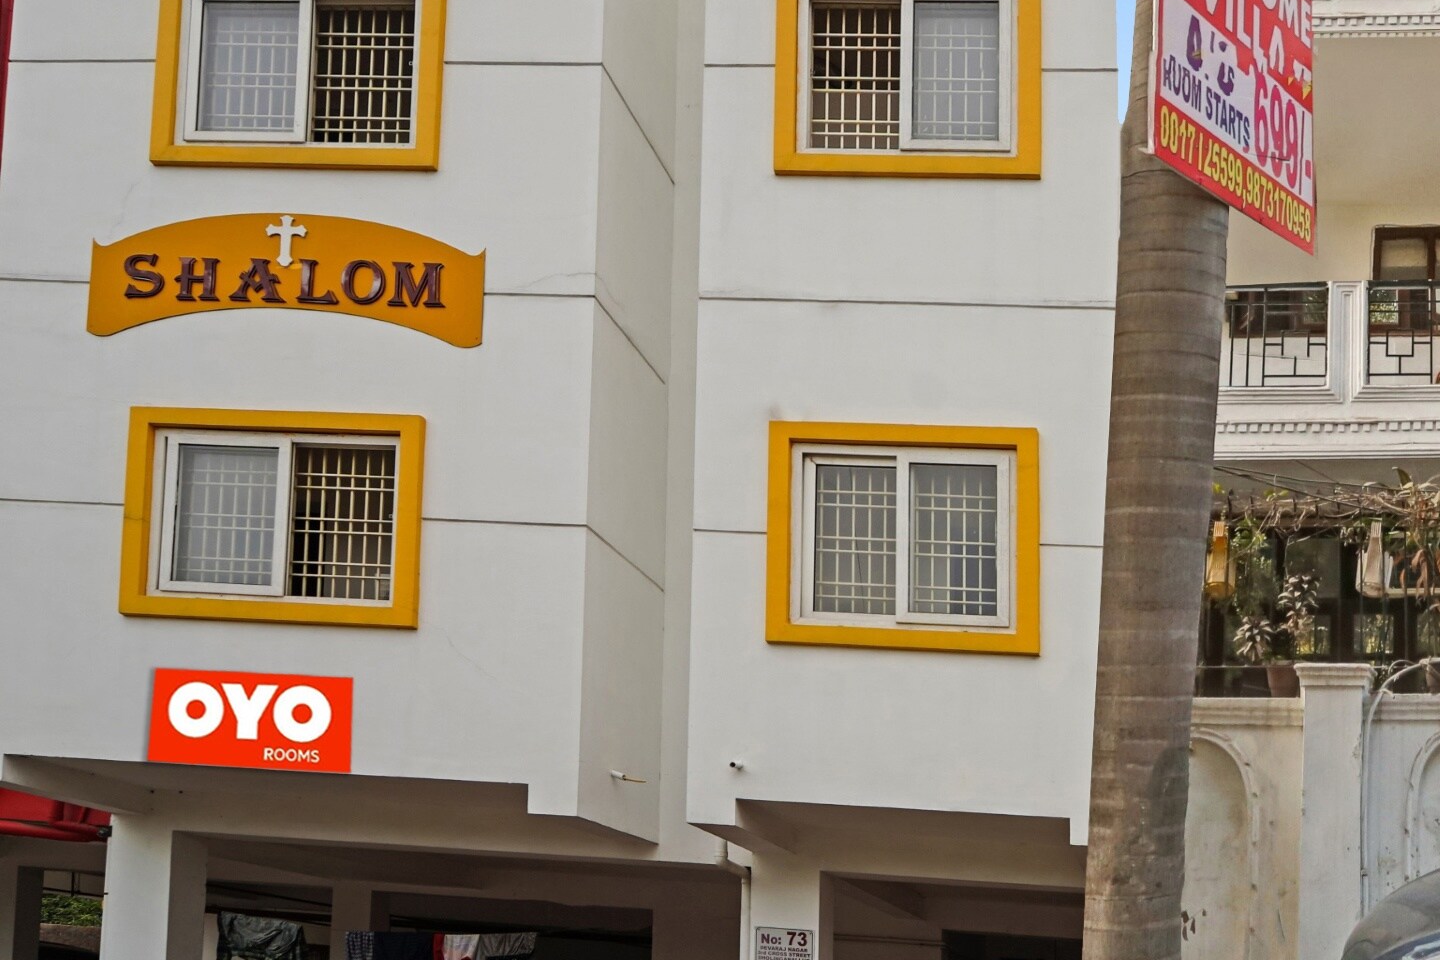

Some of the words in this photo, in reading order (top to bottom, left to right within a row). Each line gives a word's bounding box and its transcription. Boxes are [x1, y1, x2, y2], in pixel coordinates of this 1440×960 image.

[1206, 86, 1250, 149] STARTS
[124, 253, 446, 309] SHALOM
[168, 681, 332, 743] OYO
[263, 746, 320, 763] ROOMS
[760, 933, 781, 945] No:
[787, 931, 807, 946] 73
